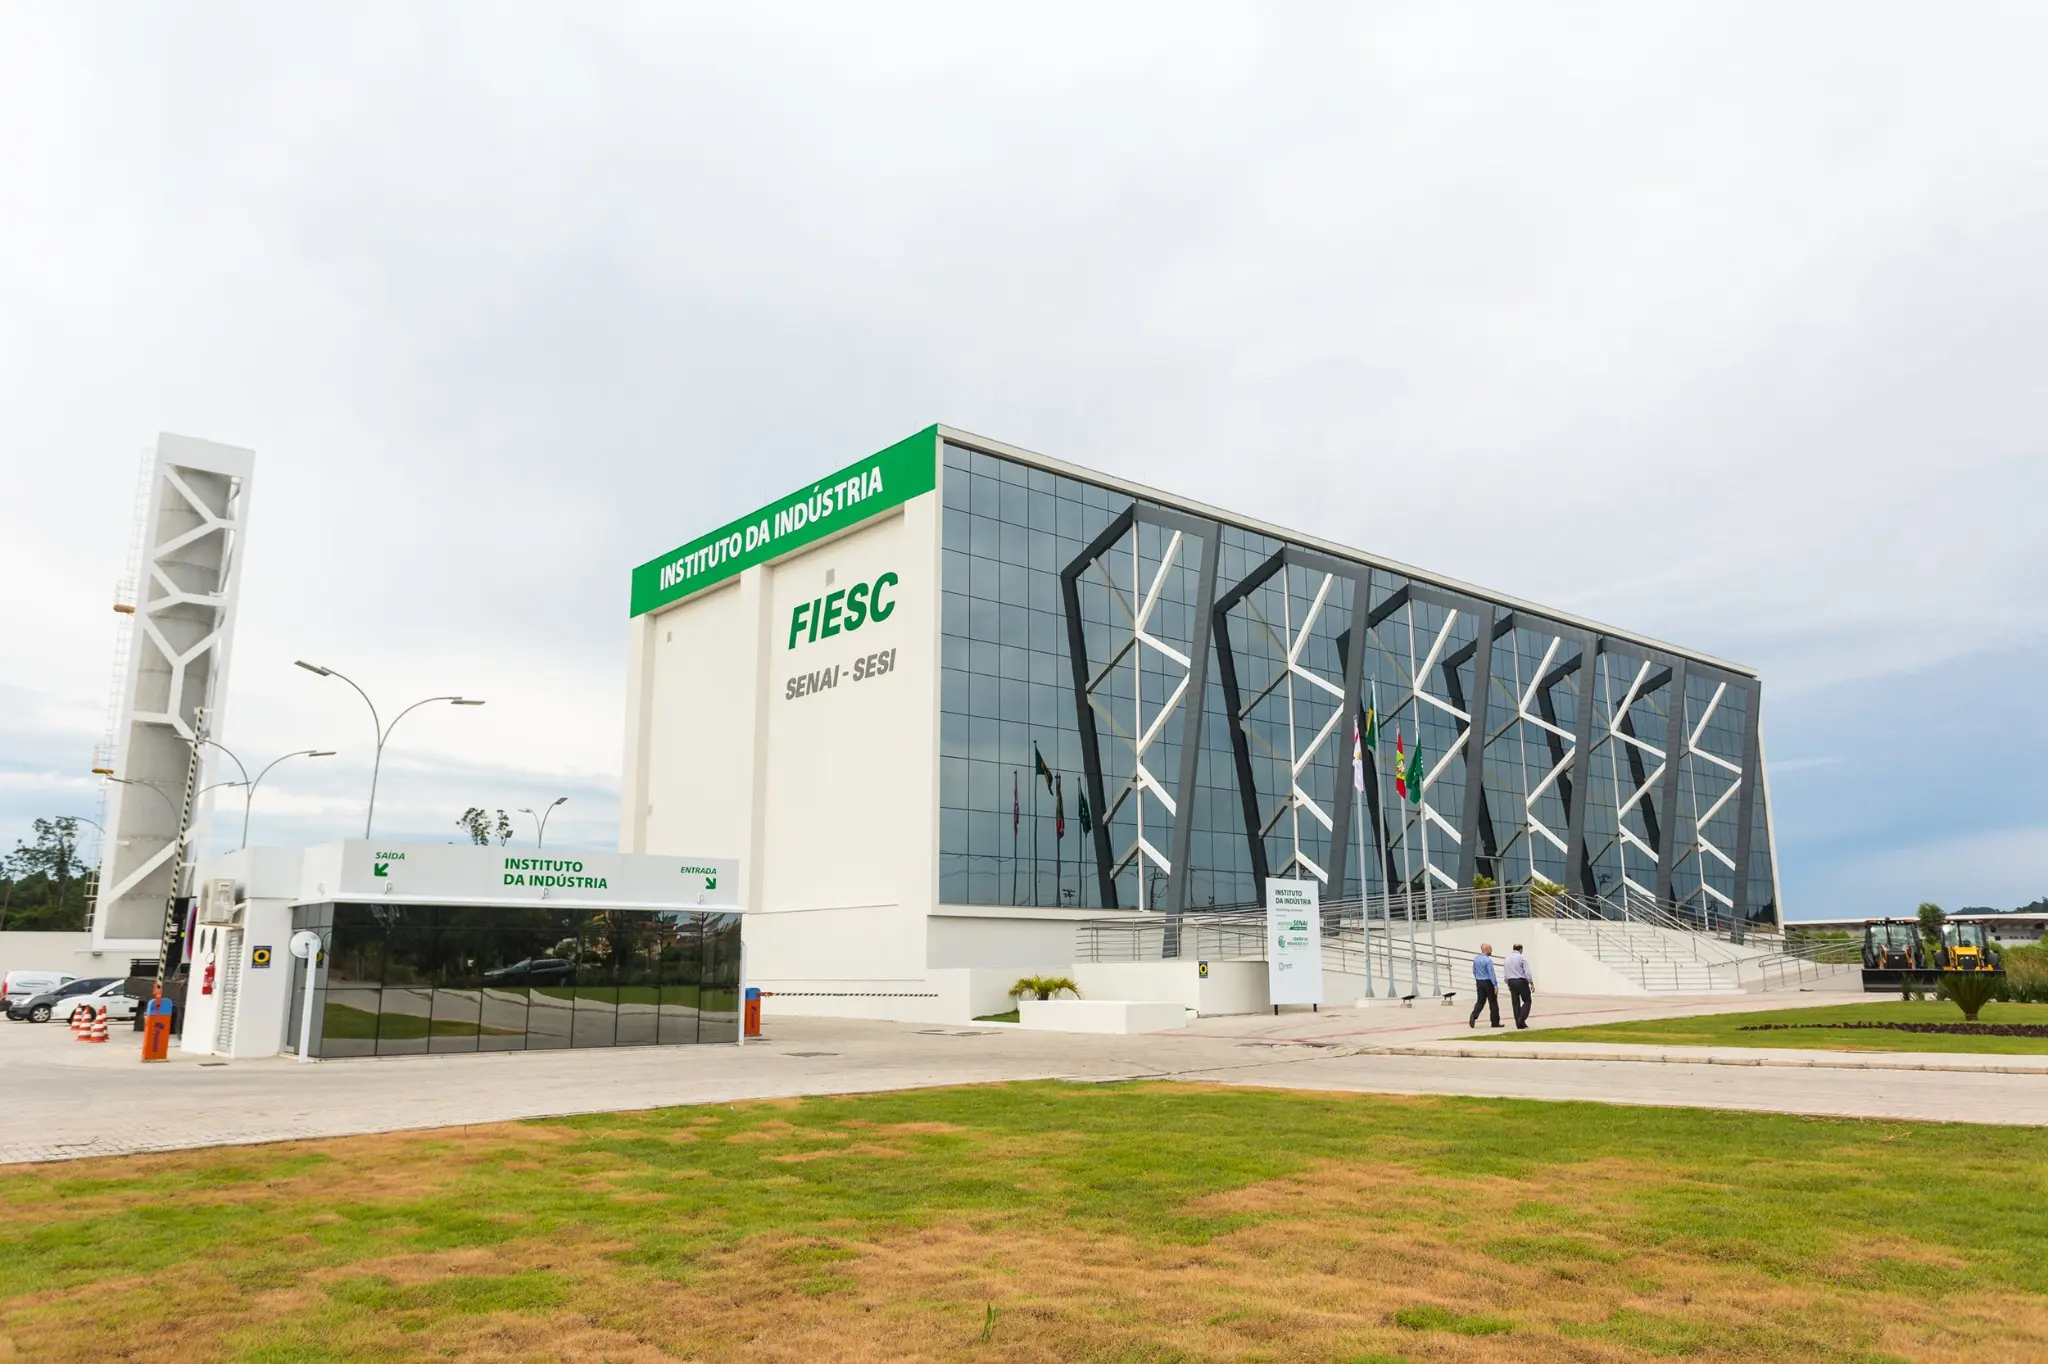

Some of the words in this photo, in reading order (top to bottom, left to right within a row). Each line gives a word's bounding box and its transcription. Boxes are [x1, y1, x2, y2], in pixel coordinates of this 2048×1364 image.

[659, 531, 742, 591] INSTITUTO
[745, 519, 770, 552] DA
[774, 466, 883, 540] INDÚSTRIA
[788, 572, 898, 650] FIESC
[785, 665, 839, 700] SENAI
[852, 648, 896, 682] SESI
[375, 850, 405, 860] SAÍDA
[504, 858, 583, 872] INSTITUTO
[680, 866, 717, 875] ENTRADA
[503, 873, 525, 886] DA
[528, 874, 608, 889] INDÚSTRIA
